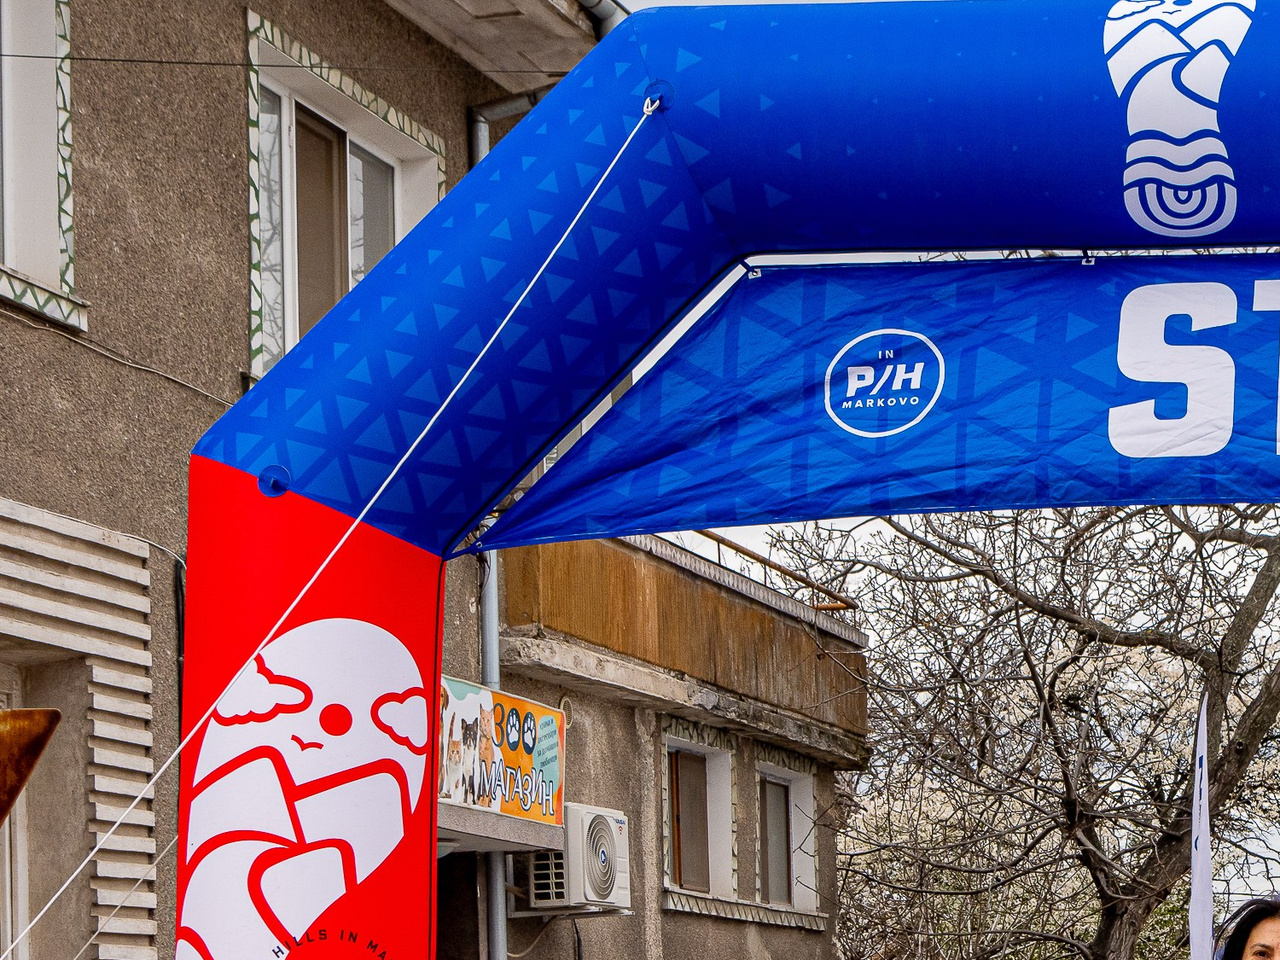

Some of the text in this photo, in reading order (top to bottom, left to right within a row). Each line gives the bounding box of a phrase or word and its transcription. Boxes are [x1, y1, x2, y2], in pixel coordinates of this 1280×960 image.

[878, 349, 894, 359] IN
[846, 362, 925, 398] P/H
[841, 396, 920, 409] MARKOVO
[479, 758, 555, 816] МАГАЗИН
